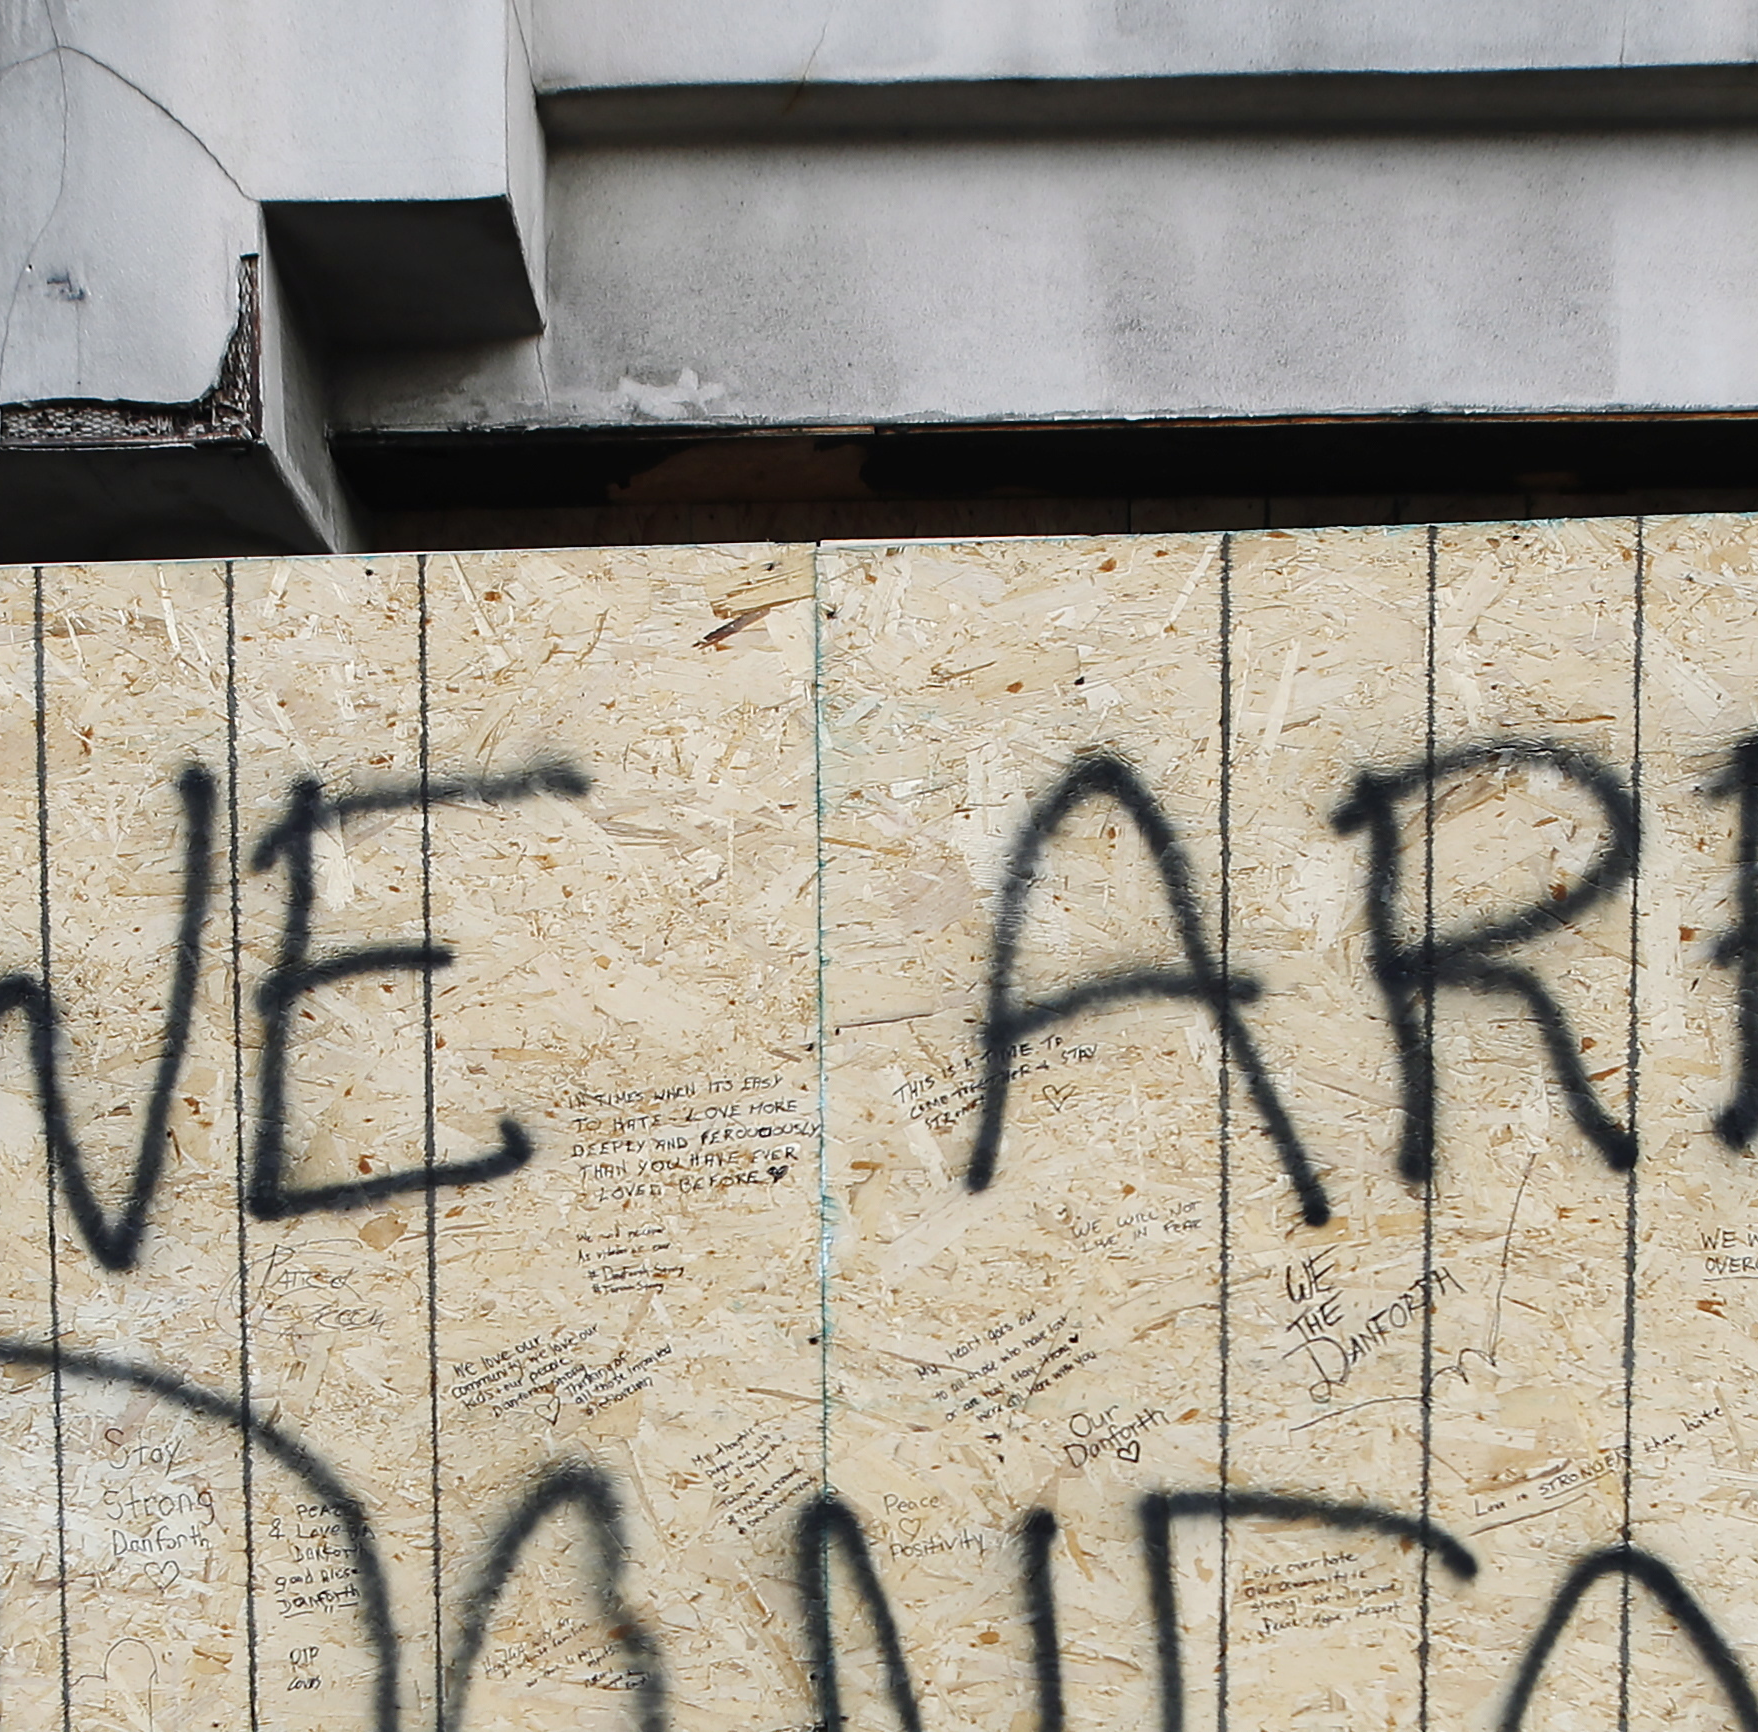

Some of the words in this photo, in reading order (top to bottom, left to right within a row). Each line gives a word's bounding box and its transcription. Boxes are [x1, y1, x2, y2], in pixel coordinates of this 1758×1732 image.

[892, 1074, 936, 1104] THIS
[685, 1104, 741, 1122] LOVE
[749, 1100, 798, 1115] MORE
[655, 1137, 688, 1150] AND
[579, 1162, 626, 1180] THAN
[638, 1160, 680, 1176] YOU
[1071, 1219, 1101, 1239] WE
[1169, 1201, 1201, 1218] NOT
[1700, 1227, 1736, 1250] WE
[1286, 1245, 1339, 1304] WE
[1285, 1290, 1344, 1342] THE
[1282, 1266, 1468, 1404] DANFORTH
[1069, 1405, 1119, 1438] Our
[105, 1428, 182, 1477] Stay
[1064, 1407, 1171, 1469] Danforth
[884, 1494, 939, 1515] Peace
[113, 1525, 210, 1556] Danforth
